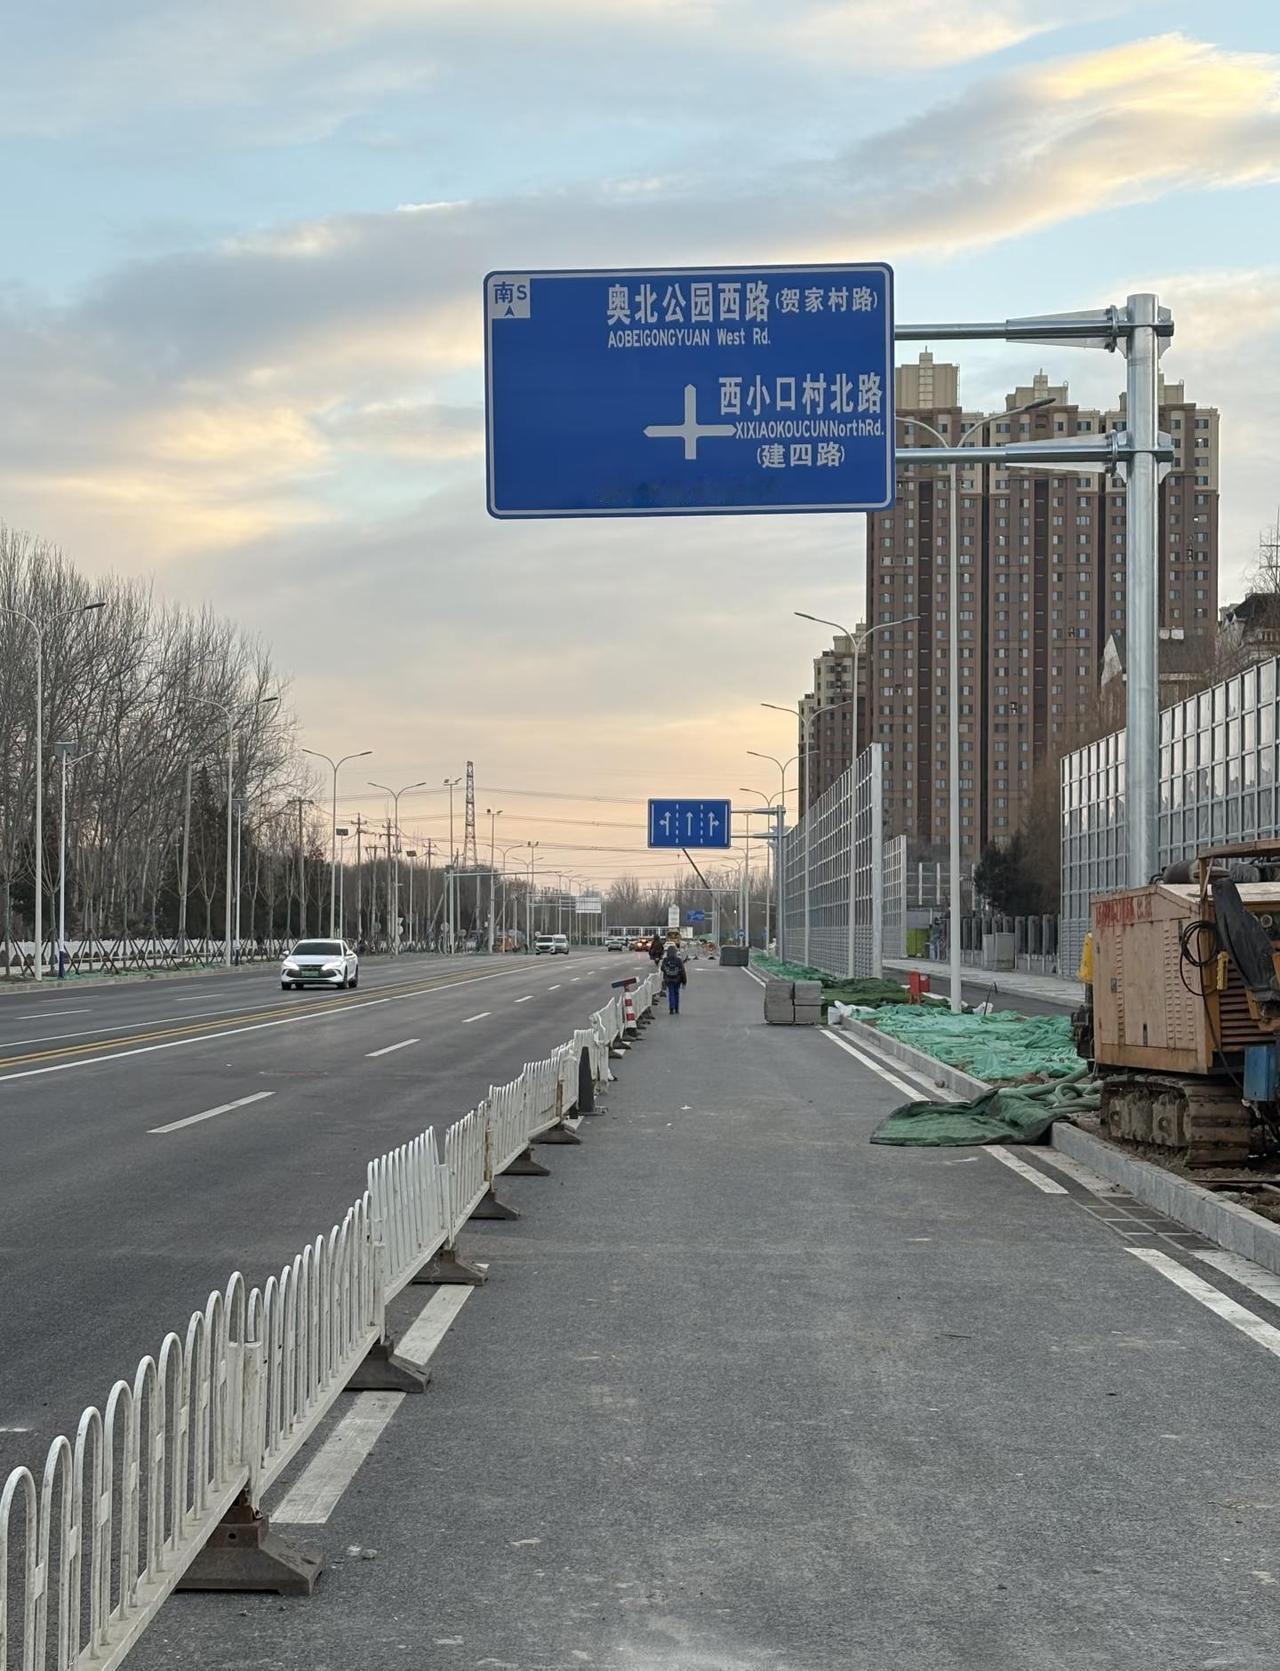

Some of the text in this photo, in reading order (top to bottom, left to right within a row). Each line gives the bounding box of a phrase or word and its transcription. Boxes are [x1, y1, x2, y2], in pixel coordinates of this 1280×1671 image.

[607, 280, 878, 325] 奥北公园西路 (贺家村路)
[607, 327, 771, 348] AOBEIGONGYUAN West Rd.
[718, 372, 883, 416] 西小口村北路
[756, 442, 845, 468] (建四路)
